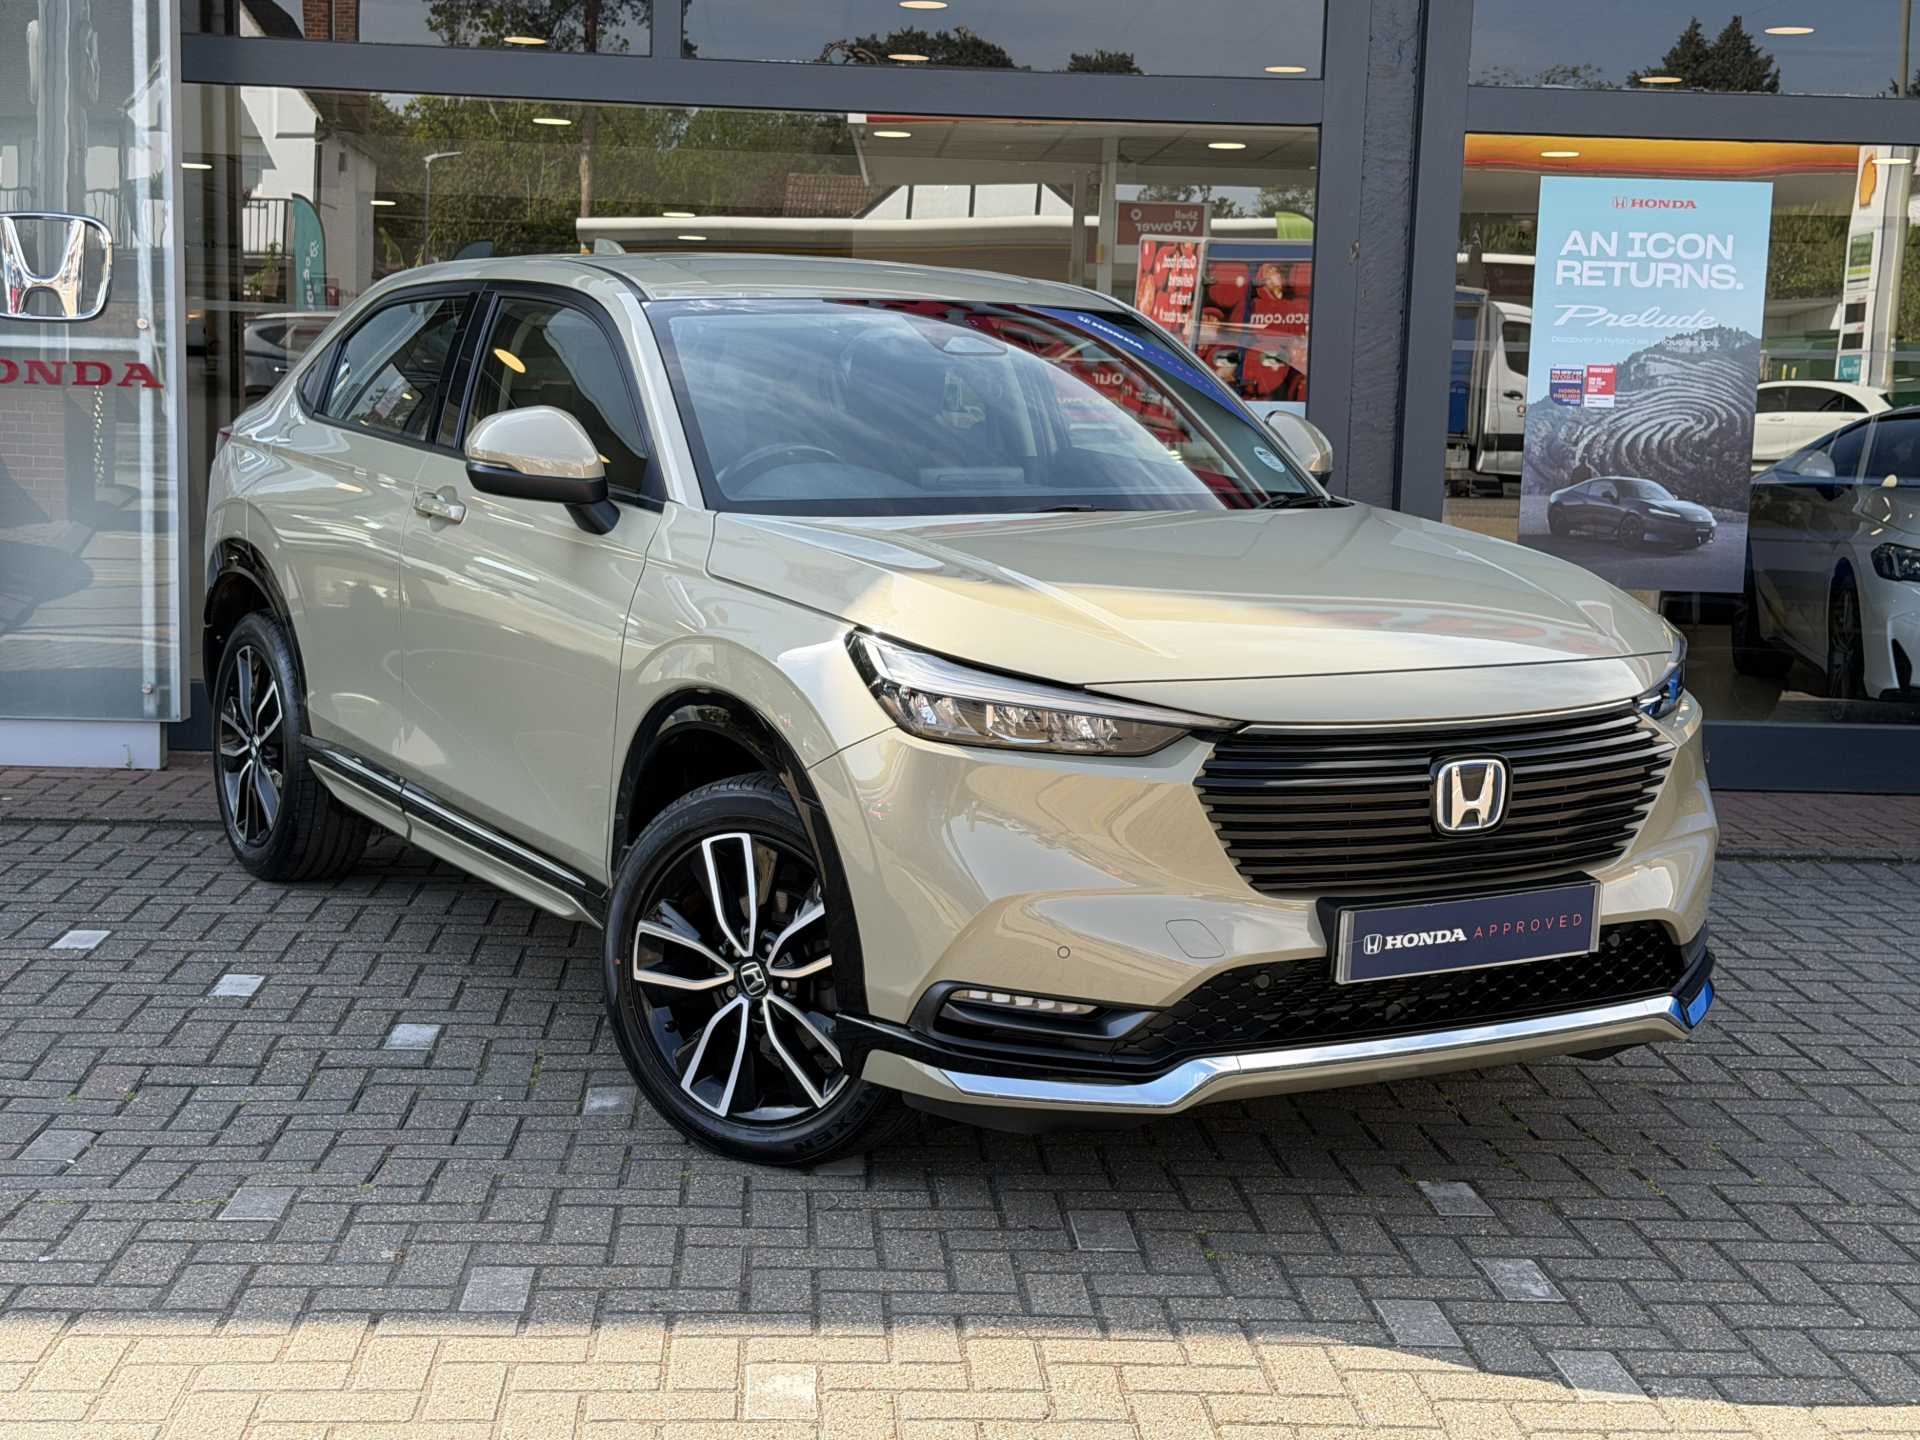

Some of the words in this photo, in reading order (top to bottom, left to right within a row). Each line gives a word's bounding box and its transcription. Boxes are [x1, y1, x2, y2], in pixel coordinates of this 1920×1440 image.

[1630, 198, 1697, 209] HONDA
[1560, 230, 1618, 257] AN
[1627, 232, 1735, 260] ICON
[1555, 260, 1745, 290] RETURNS.
[1552, 304, 1720, 329] Prelude
[1384, 928, 1467, 950] HONDA
[1472, 912, 1584, 940] APPROVED
